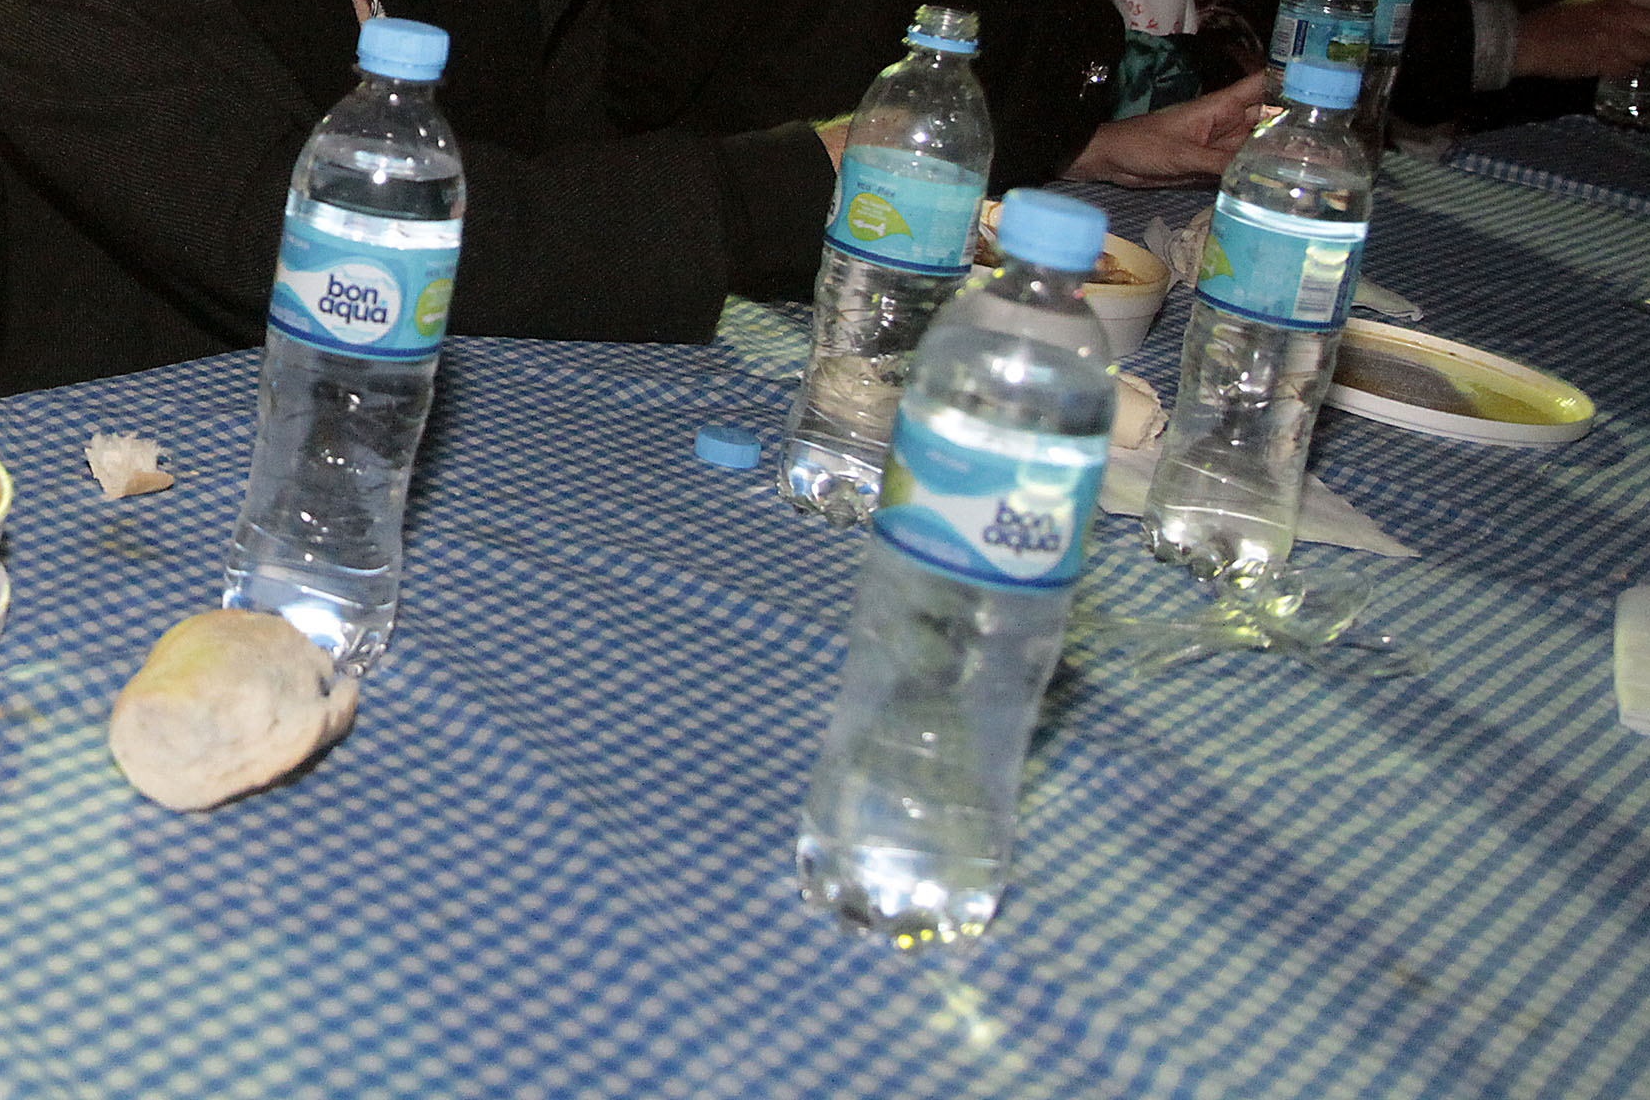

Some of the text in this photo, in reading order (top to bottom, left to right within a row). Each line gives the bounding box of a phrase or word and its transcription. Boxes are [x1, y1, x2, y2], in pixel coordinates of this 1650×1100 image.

[329, 274, 378, 304] bon
[319, 297, 387, 324] aqua
[997, 499, 1053, 532] bon
[983, 525, 1059, 555] aqua
